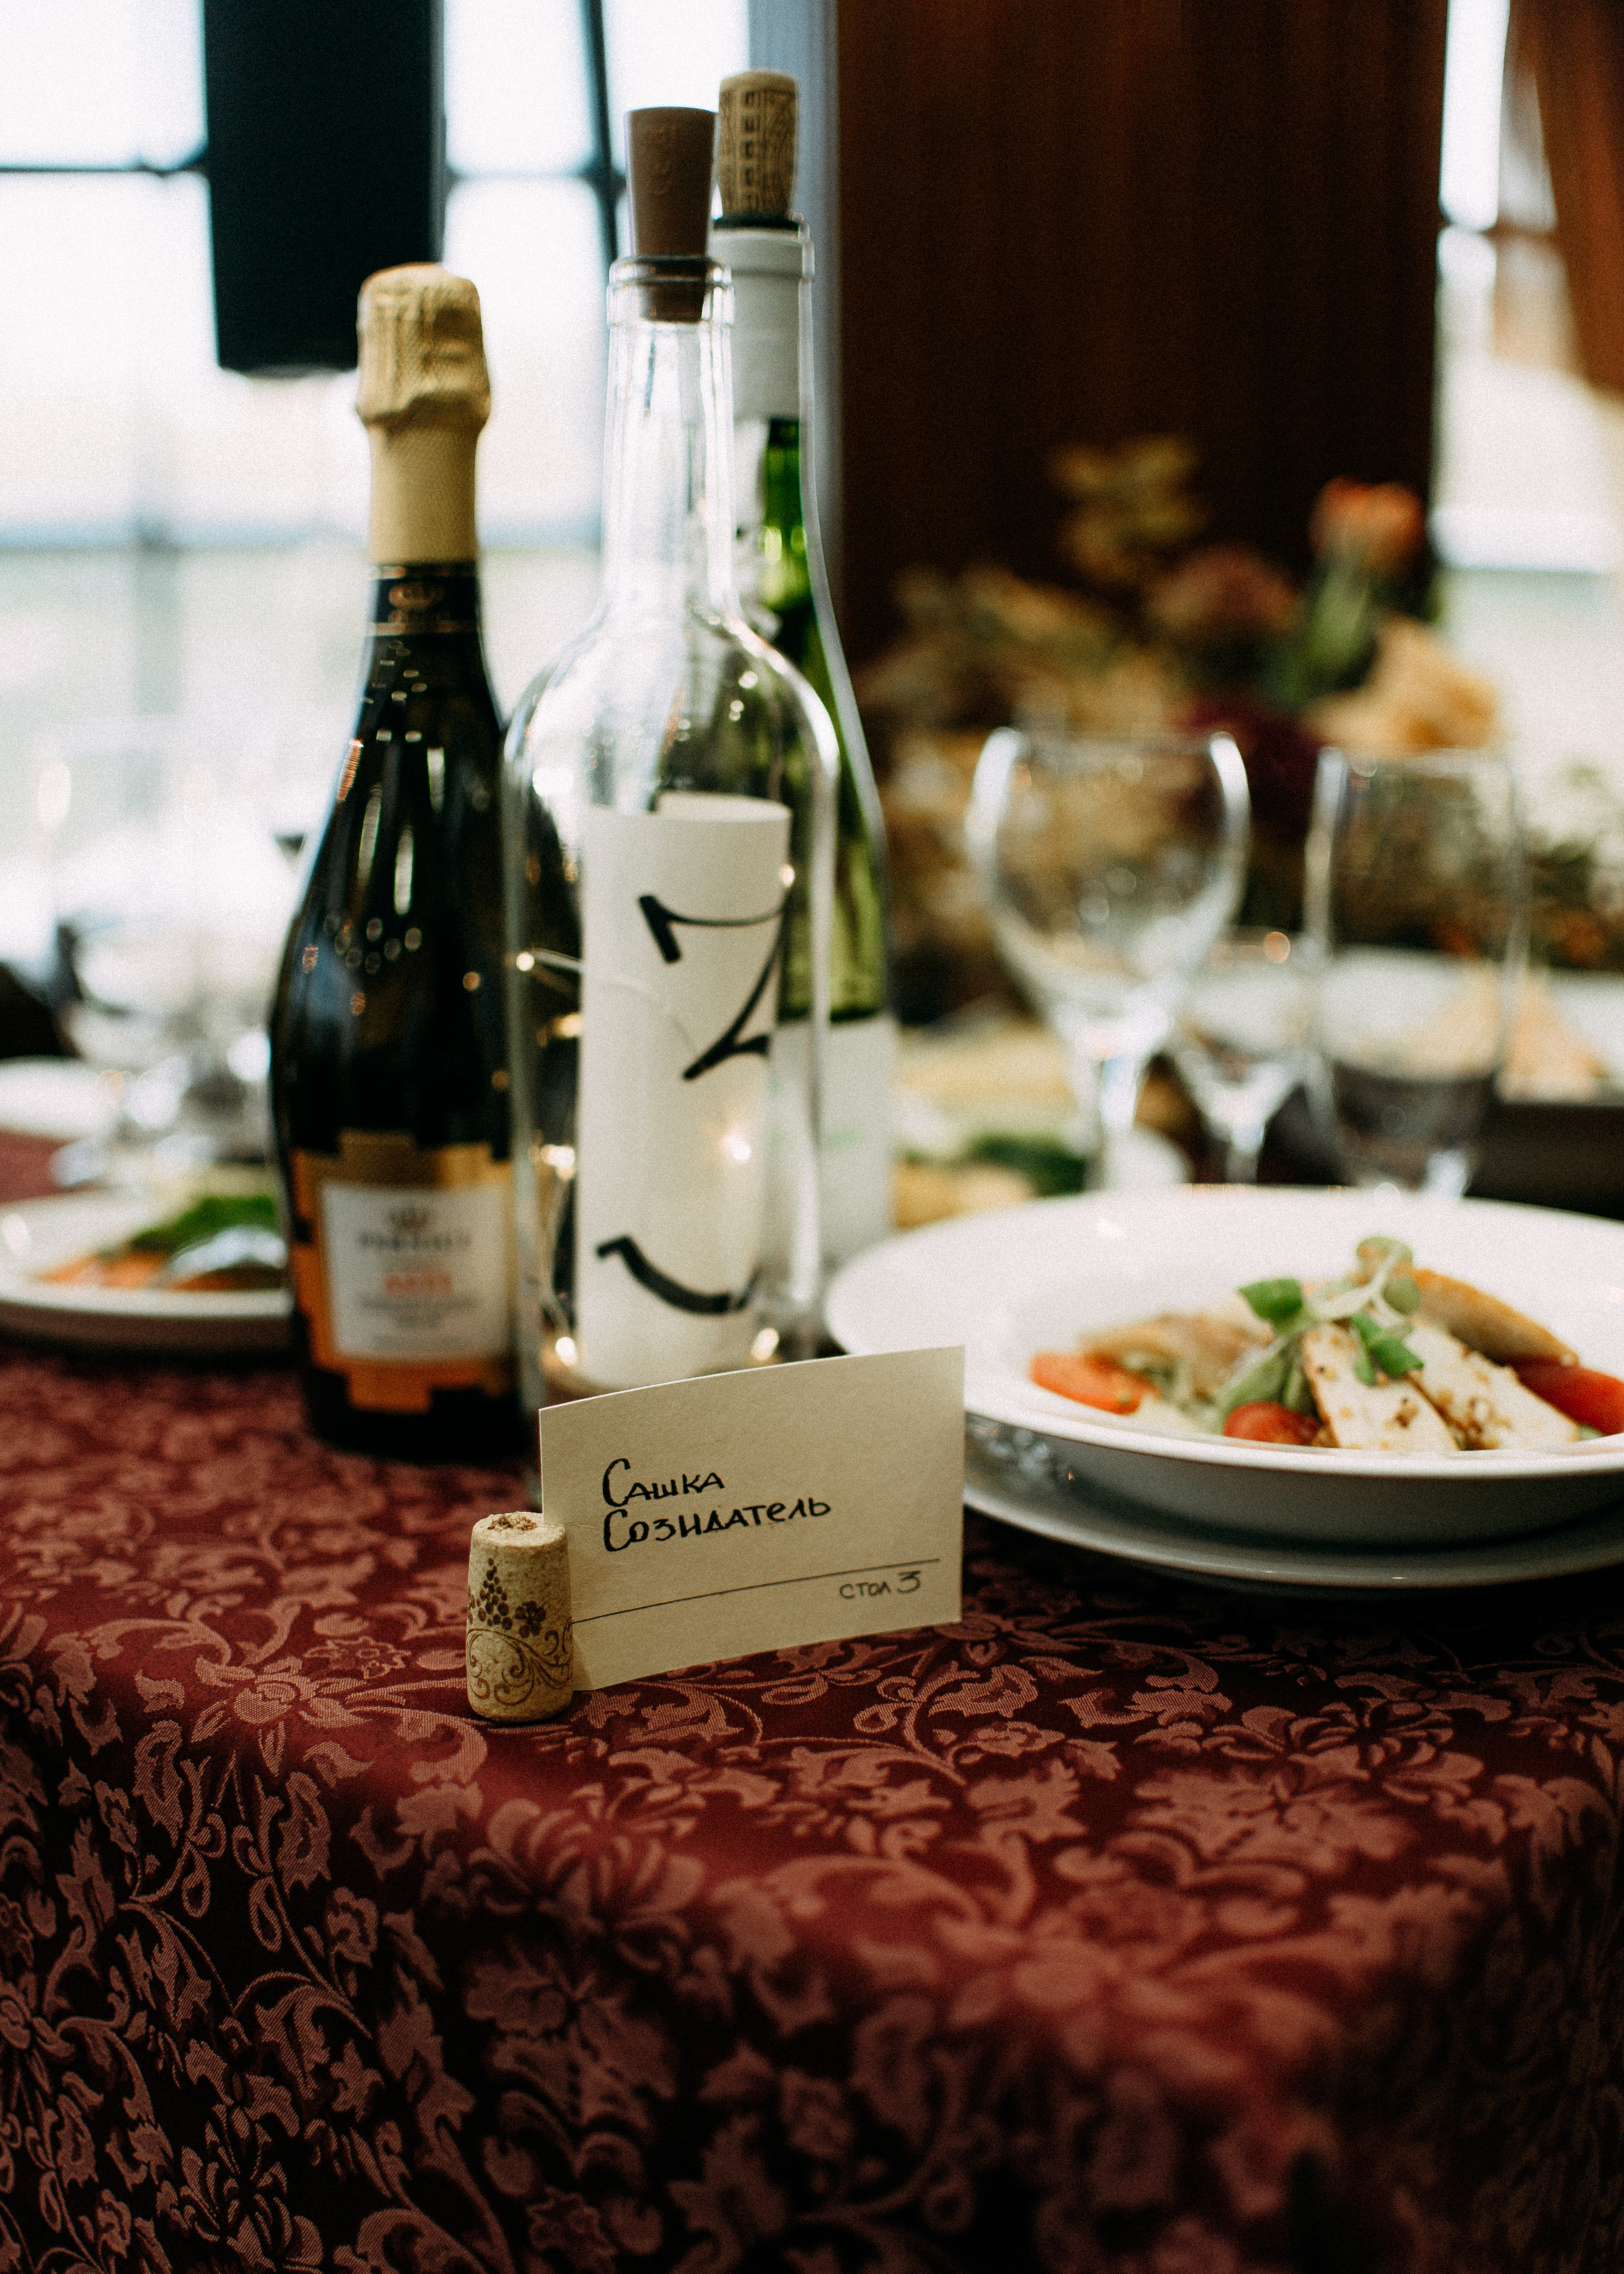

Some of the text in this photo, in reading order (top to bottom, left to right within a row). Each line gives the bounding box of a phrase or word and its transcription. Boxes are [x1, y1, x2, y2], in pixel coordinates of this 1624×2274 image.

[603, 1458, 725, 1507] Сашка
[604, 1497, 831, 1551] Созидатель
[839, 1570, 921, 1599] стол 3
